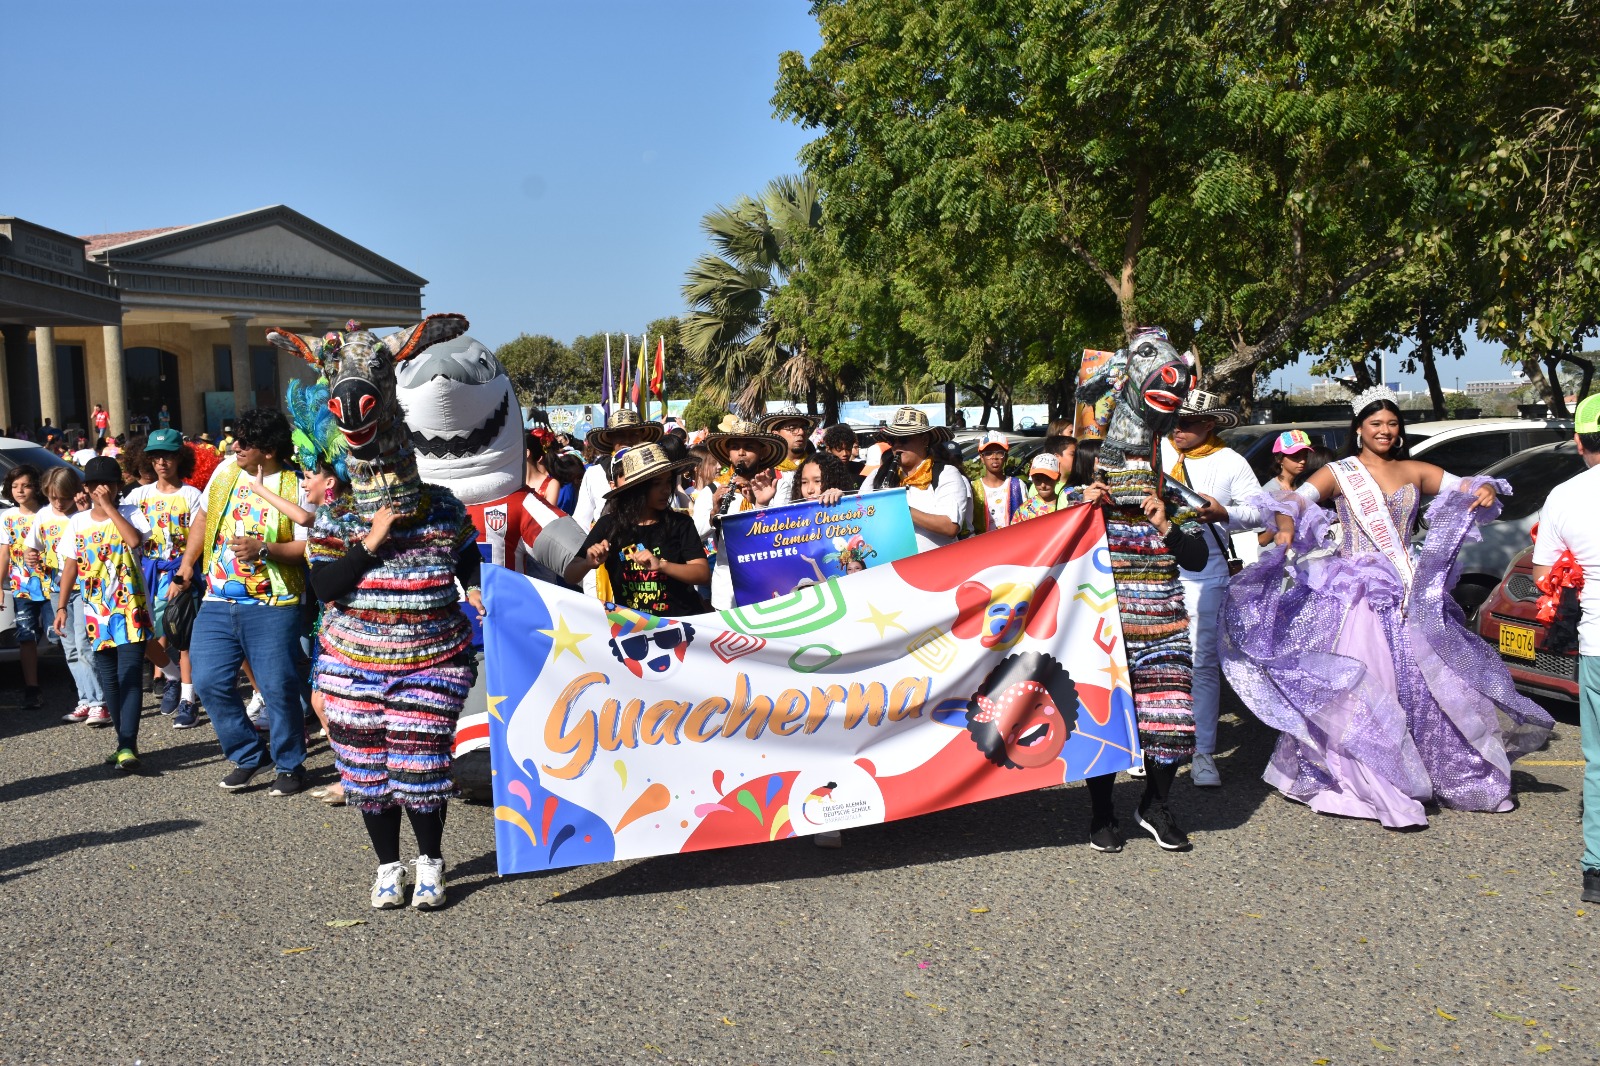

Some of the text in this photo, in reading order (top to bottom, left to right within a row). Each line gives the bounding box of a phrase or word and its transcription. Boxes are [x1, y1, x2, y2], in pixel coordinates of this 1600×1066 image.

[746, 505, 876, 537] Madelein Chacón &
[1356, 489, 1379, 517] JUVENIL
[1368, 518, 1393, 551] CARNAVAL
[773, 524, 861, 548] Samuel Otero
[737, 546, 798, 563] REYES DE K6
[541, 671, 932, 781] Guacherna
[823, 804, 844, 812] COLEGIO
[824, 809, 850, 818] DEUTSCHE
